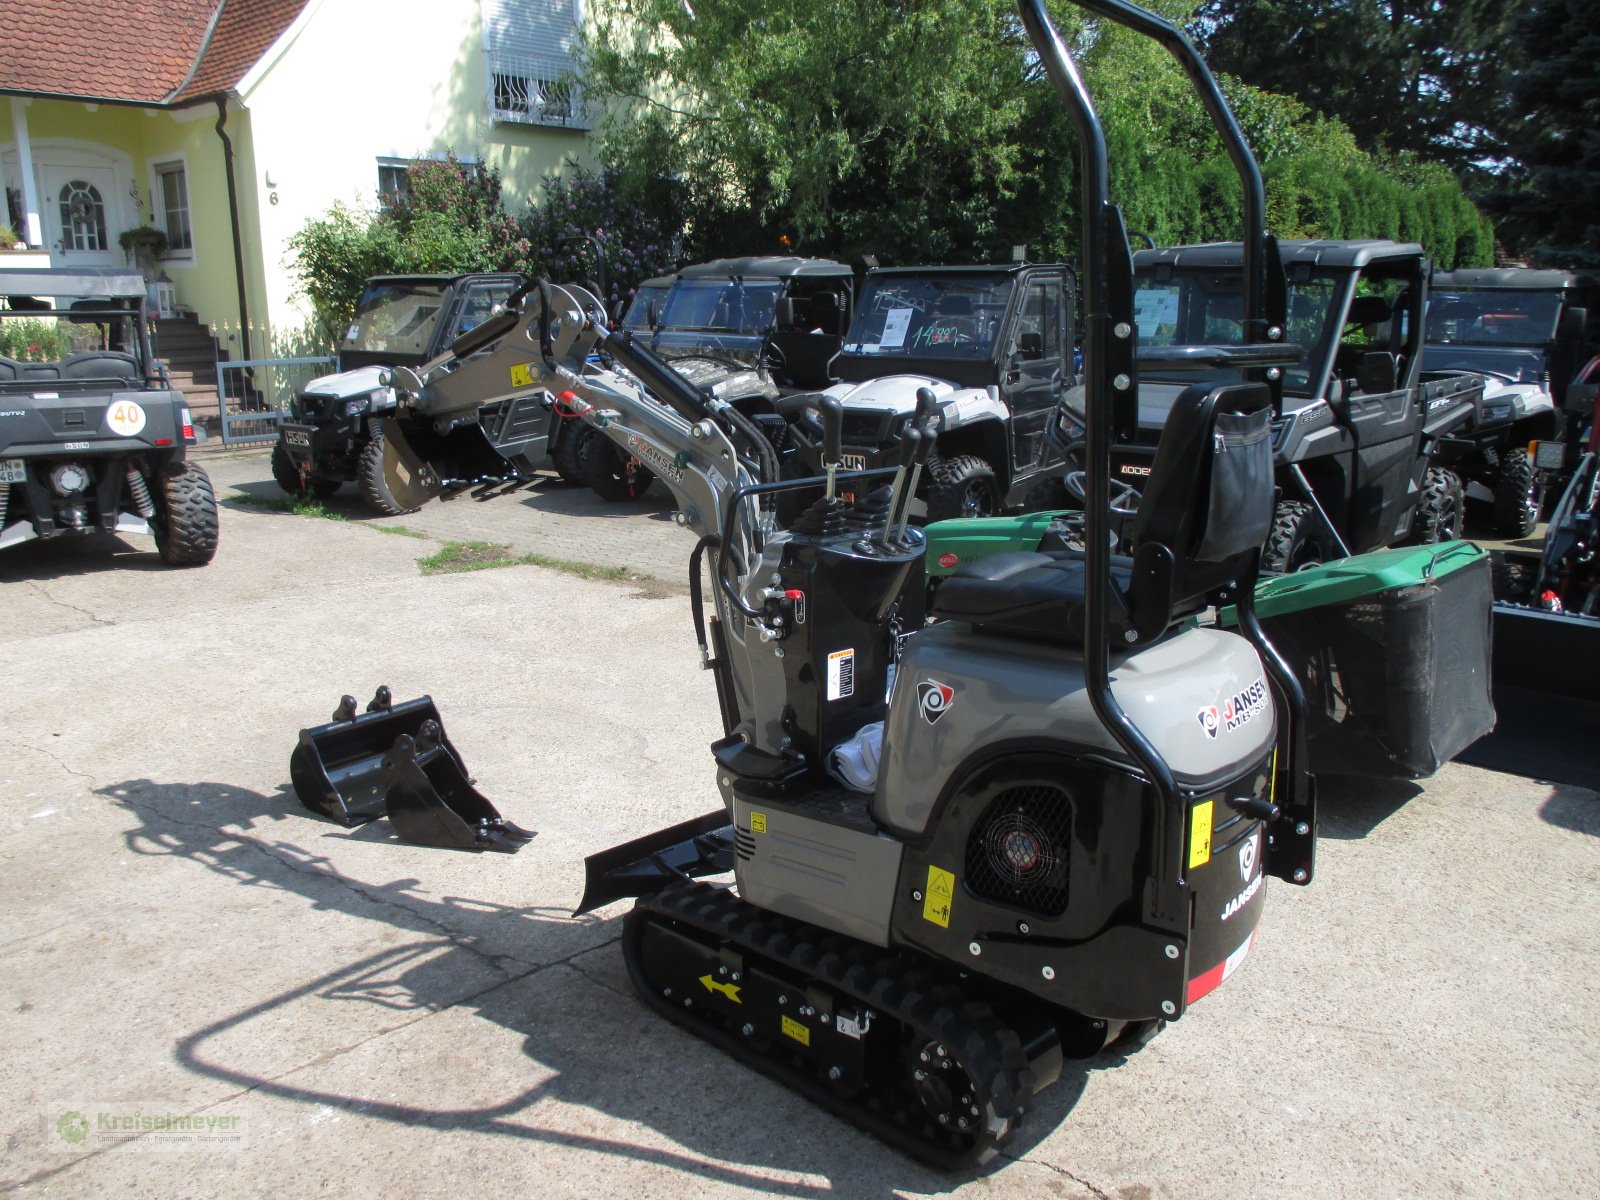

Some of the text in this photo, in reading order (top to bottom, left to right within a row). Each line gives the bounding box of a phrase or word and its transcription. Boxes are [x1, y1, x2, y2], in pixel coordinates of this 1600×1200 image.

[269, 191, 279, 206] 6
[113, 404, 140, 424] 40
[640, 441, 684, 481] JANSEN
[1223, 677, 1266, 720] JANSEN
[1220, 871, 1263, 921] JANSEN
